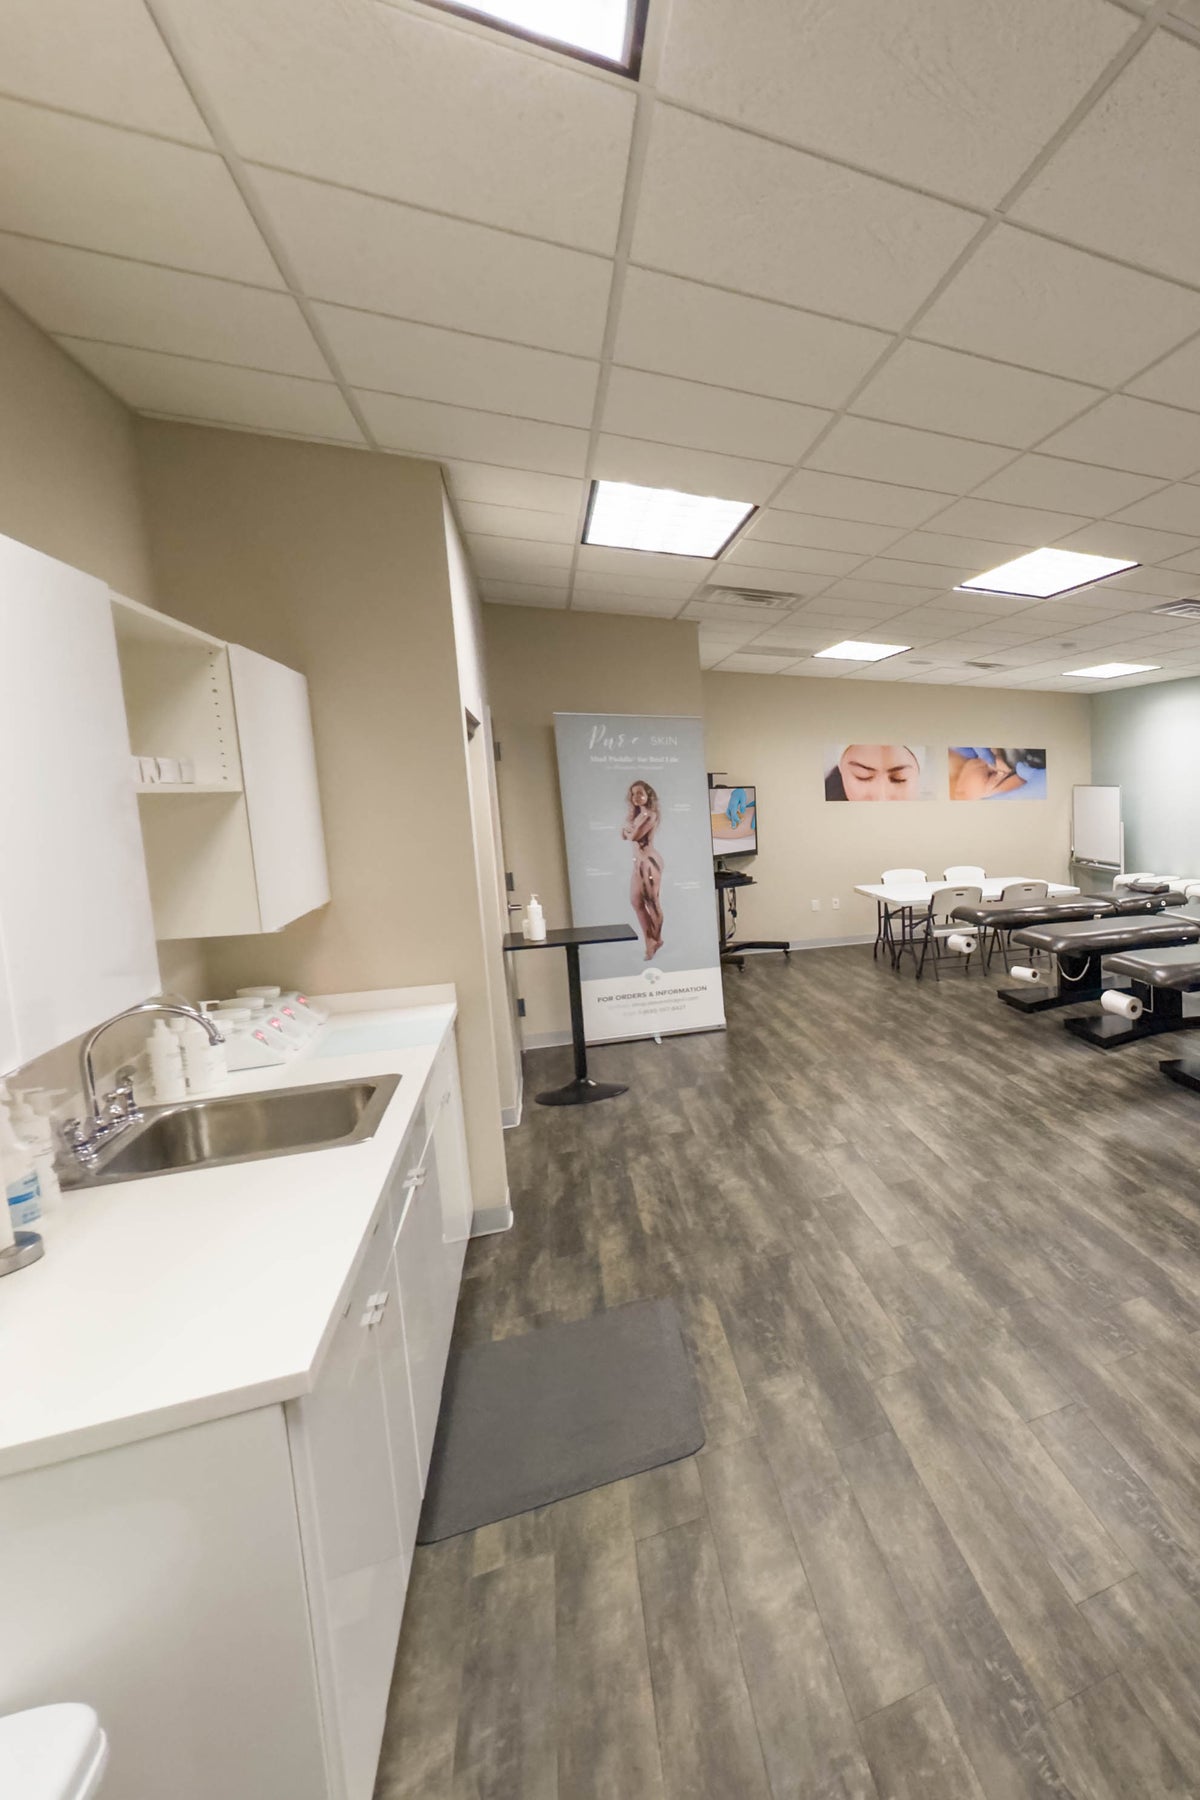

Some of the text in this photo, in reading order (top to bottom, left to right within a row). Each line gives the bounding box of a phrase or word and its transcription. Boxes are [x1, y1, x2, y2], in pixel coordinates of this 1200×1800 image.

[650, 735, 679, 746] SKIN
[597, 995, 613, 1003] FOR
[615, 991, 647, 1000] ORDERS
[656, 985, 707, 996] INFORMATION
